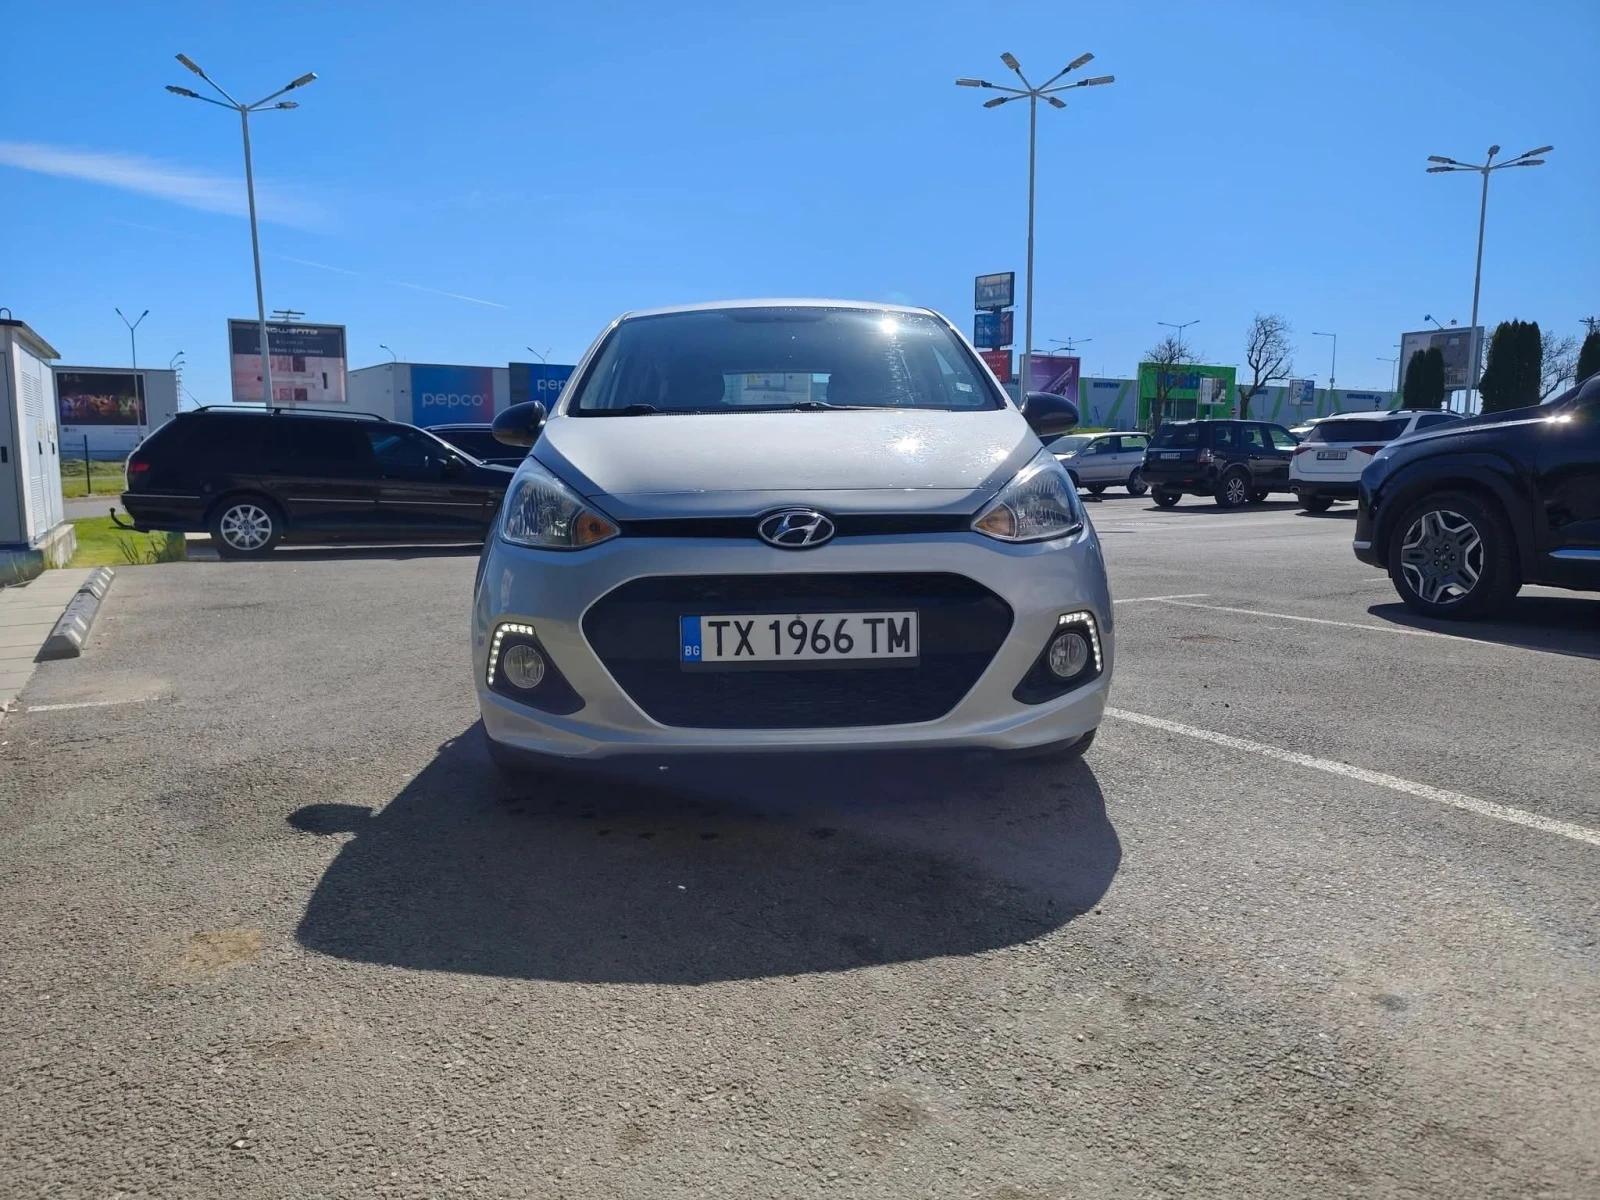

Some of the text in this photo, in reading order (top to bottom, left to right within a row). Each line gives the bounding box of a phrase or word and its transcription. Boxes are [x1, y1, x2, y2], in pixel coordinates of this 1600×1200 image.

[536, 378, 566, 392] pep
[422, 393, 484, 408] pepco
[708, 617, 910, 656] TX 1966 TM
[685, 645, 700, 656] BG
